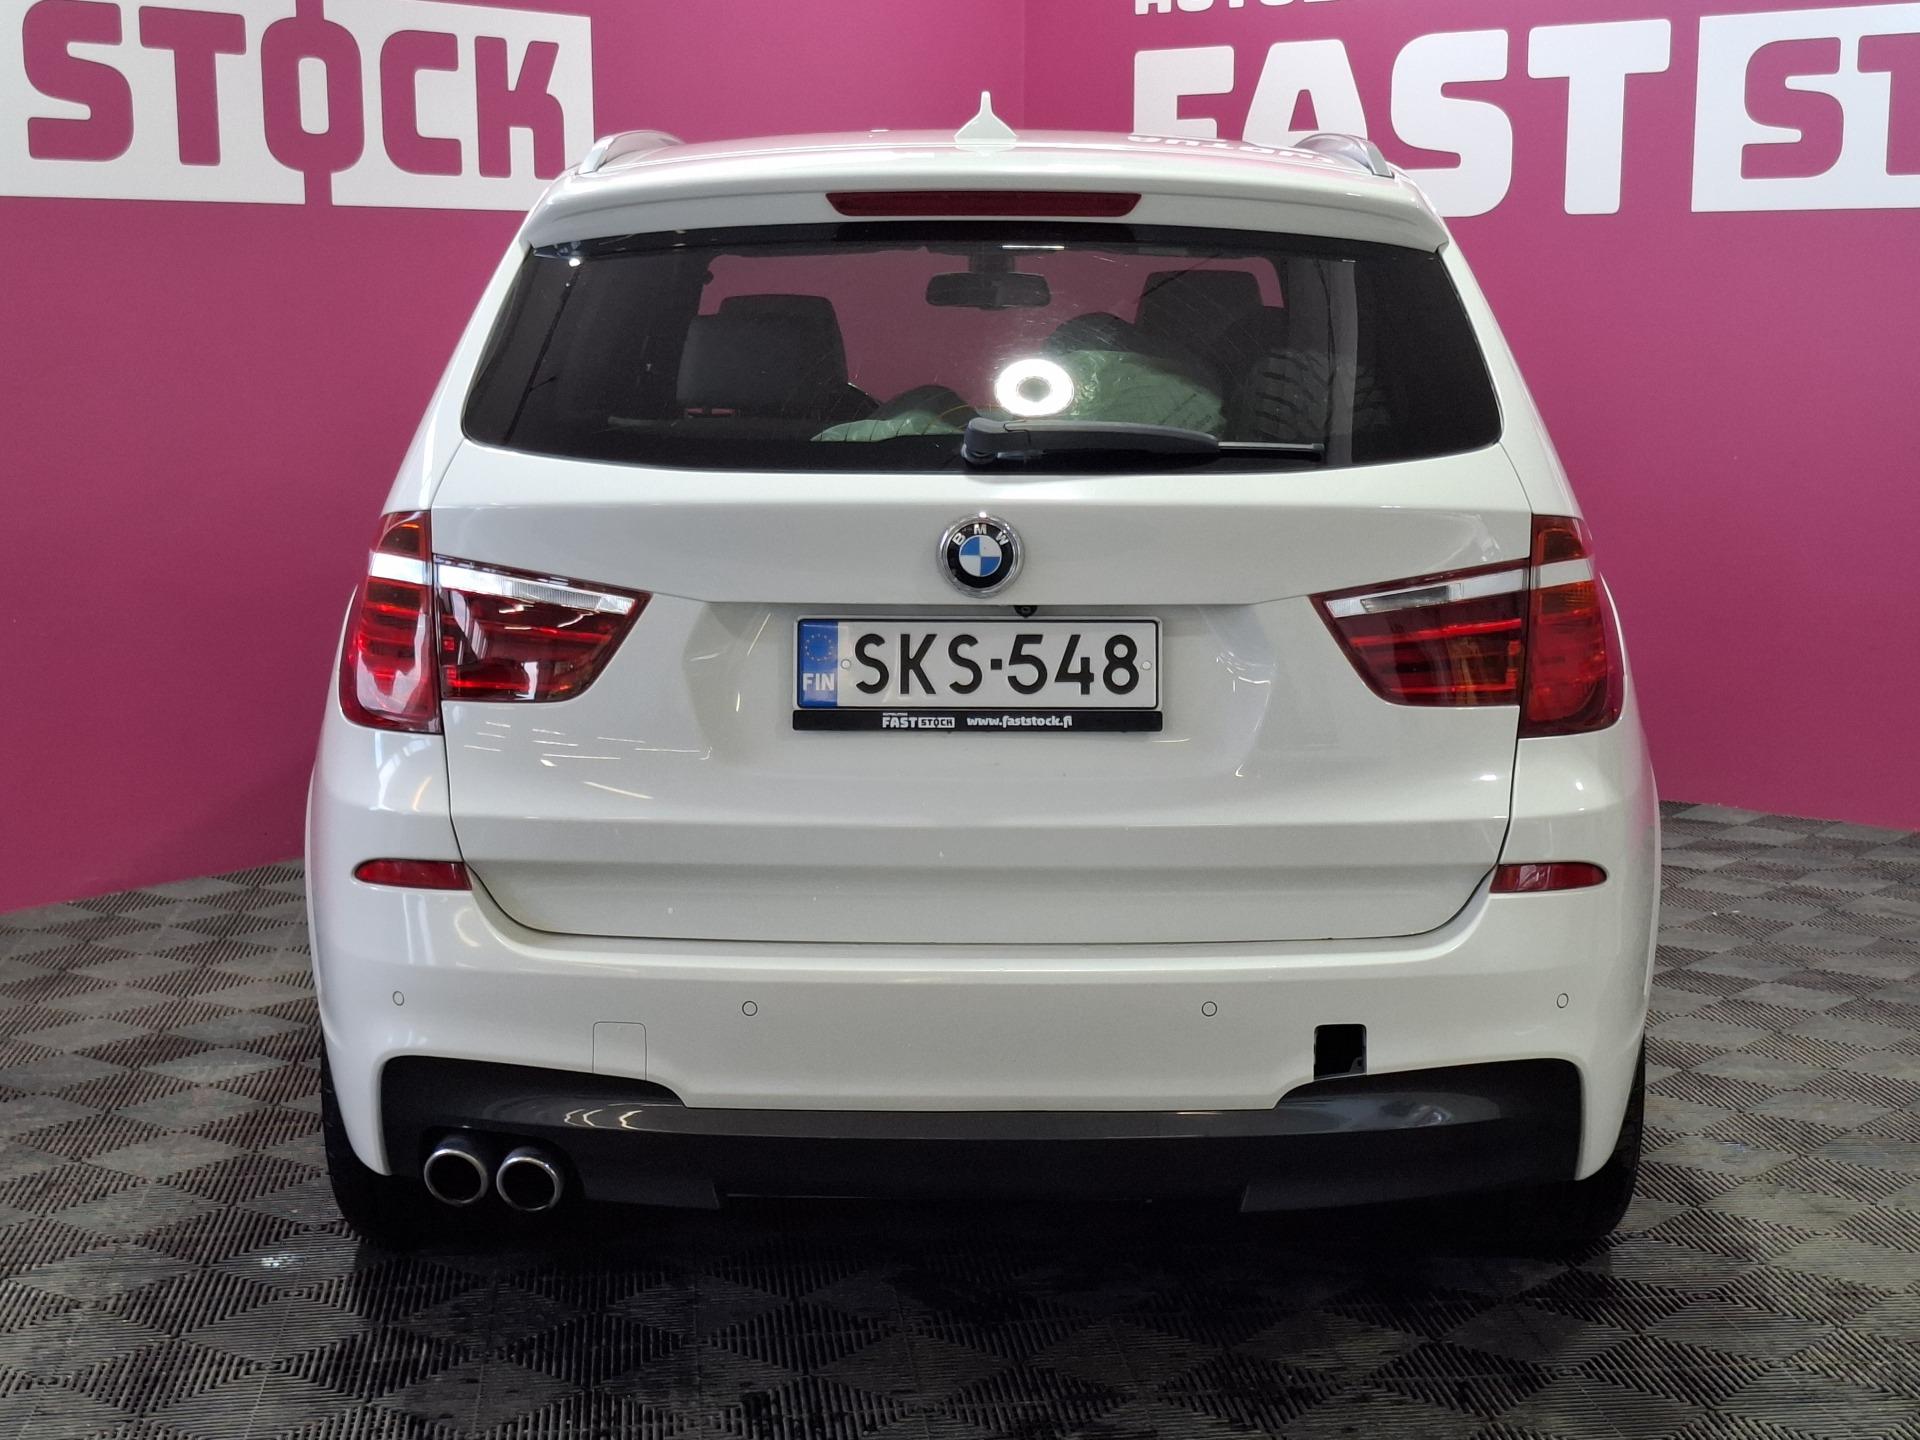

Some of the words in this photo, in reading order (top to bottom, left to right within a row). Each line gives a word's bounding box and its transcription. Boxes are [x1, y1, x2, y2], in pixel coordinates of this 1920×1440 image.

[22, 0, 565, 179] STOCK
[1133, 19, 1671, 217] FAST
[952, 523, 1009, 546] BMW
[802, 672, 835, 691] FIN
[882, 717, 917, 728] FAST
[967, 715, 1072, 728] www.faststock.fi
